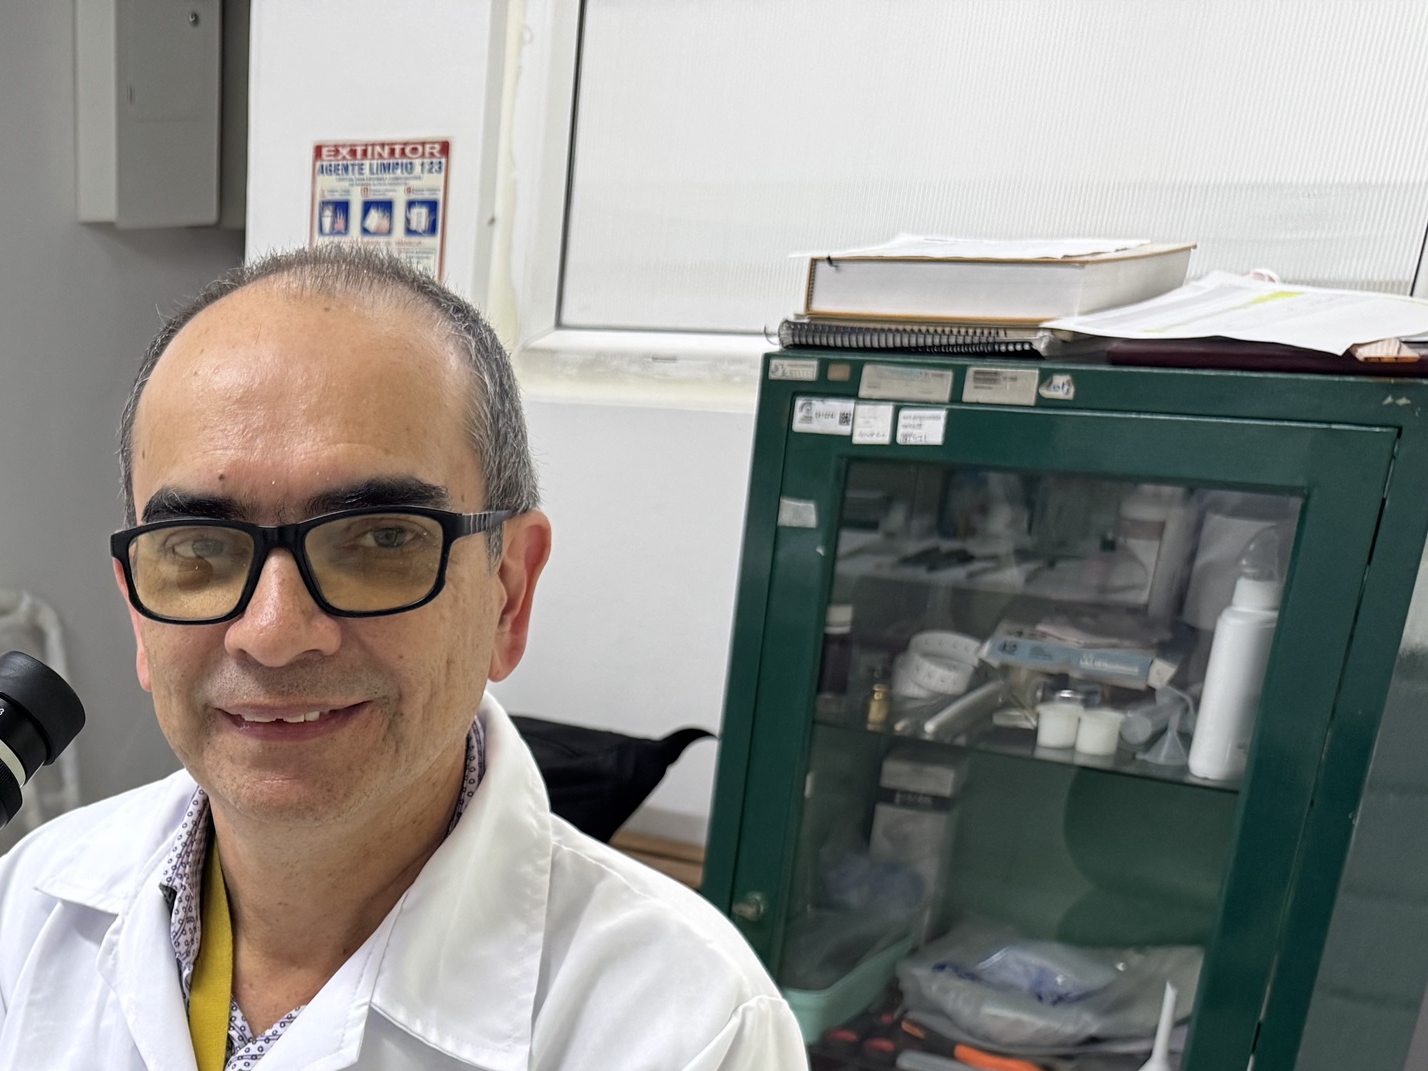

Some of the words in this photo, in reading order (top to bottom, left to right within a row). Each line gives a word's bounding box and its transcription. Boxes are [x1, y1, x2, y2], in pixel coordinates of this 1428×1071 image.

[322, 143, 440, 160] EXTINTOR
[317, 162, 365, 176] AGENTE
[369, 161, 414, 175] LIMPIO
